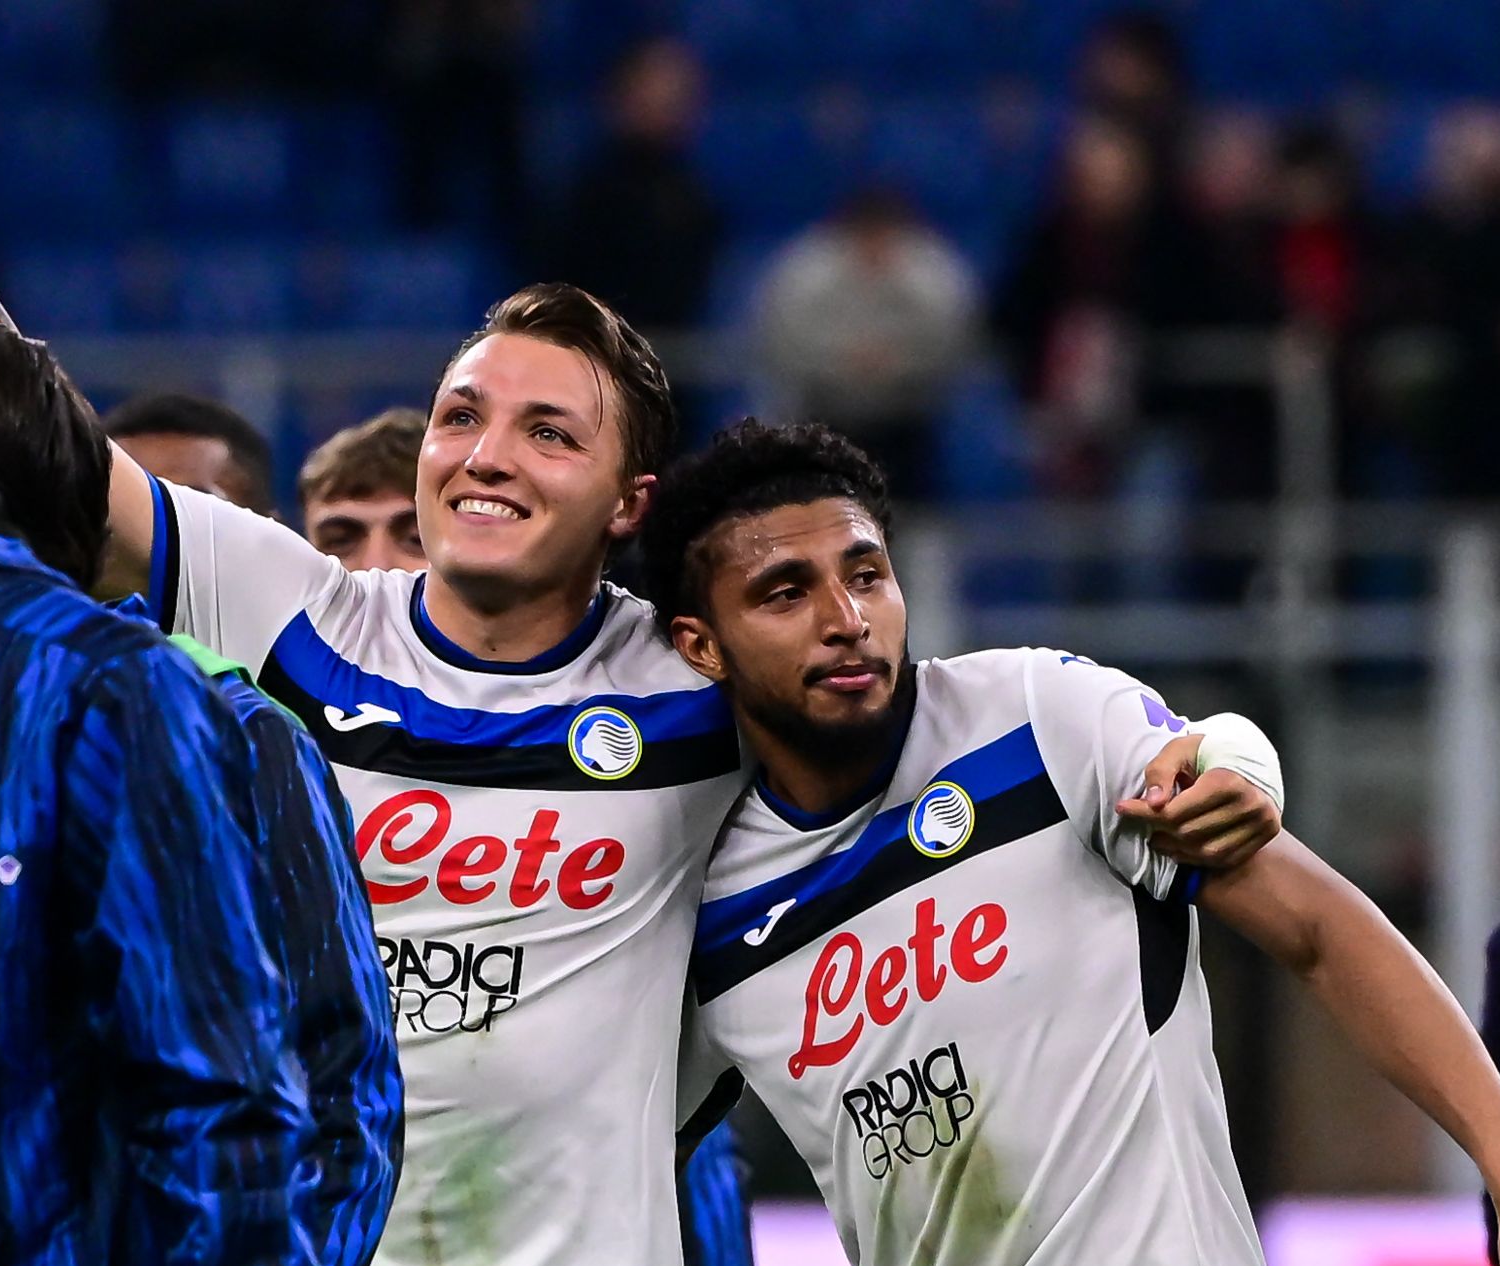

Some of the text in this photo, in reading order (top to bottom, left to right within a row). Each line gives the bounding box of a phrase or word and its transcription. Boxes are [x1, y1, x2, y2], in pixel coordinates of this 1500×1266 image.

[355, 789, 625, 911] Lete
[377, 937, 524, 995] RADICI
[389, 986, 517, 1032] ROUP
[787, 896, 1008, 1080] Lete
[841, 1042, 968, 1138] RADICI
[862, 1090, 975, 1181] GROUP
